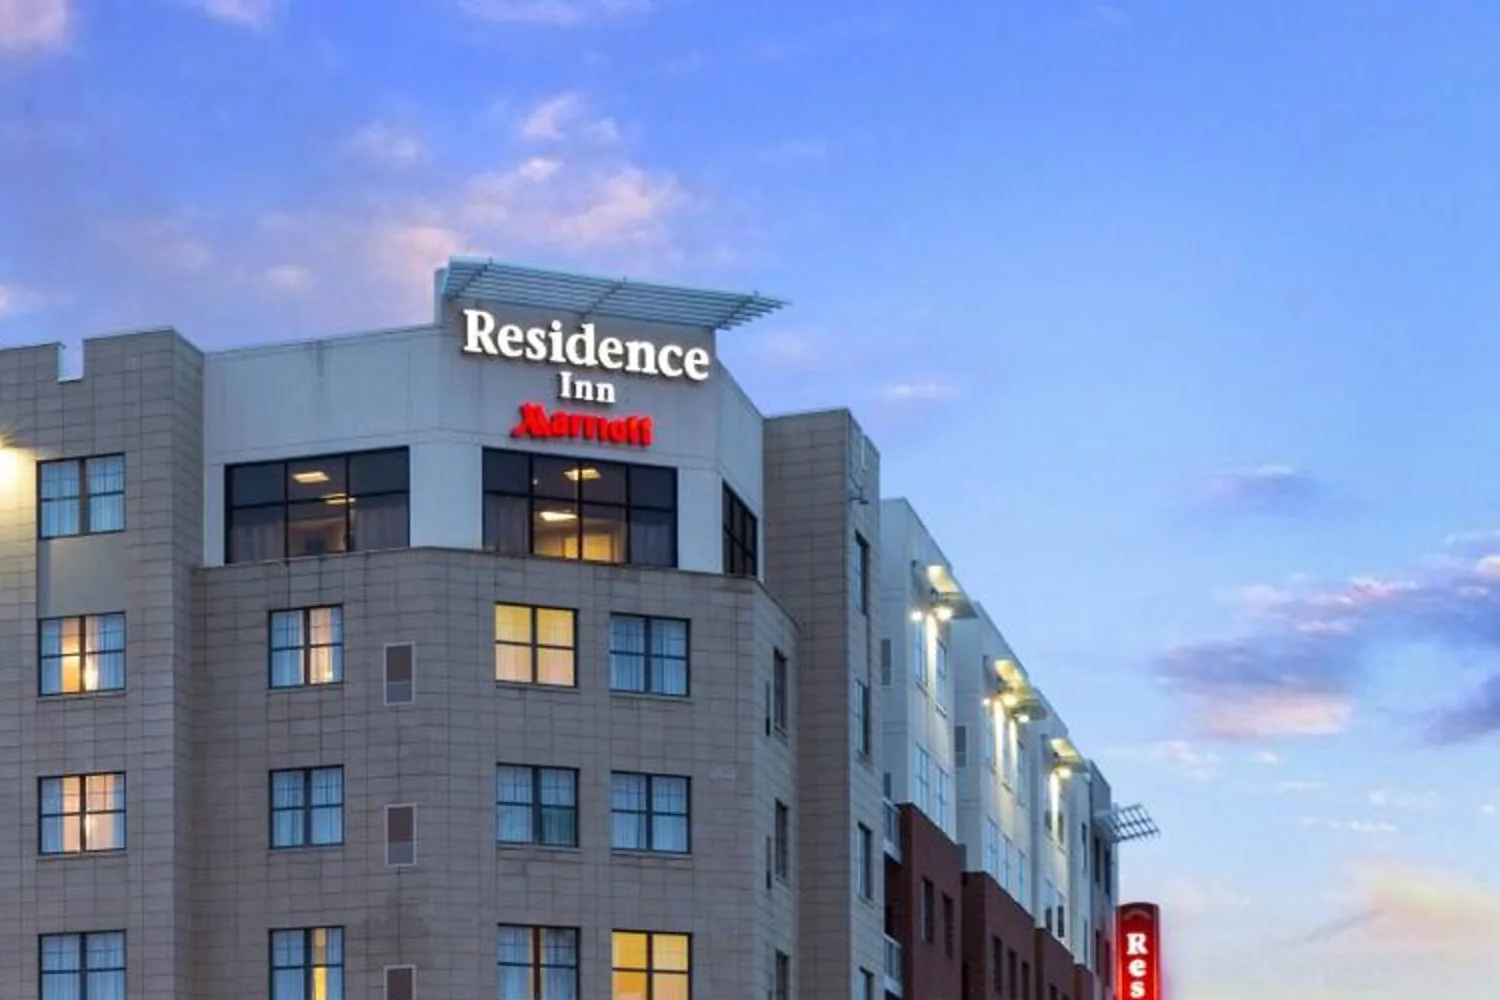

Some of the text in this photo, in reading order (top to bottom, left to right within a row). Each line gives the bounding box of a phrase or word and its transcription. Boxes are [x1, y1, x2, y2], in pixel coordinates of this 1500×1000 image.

[463, 308, 710, 380] Residence
[559, 371, 616, 403] Inn
[511, 402, 654, 446] Marriott
